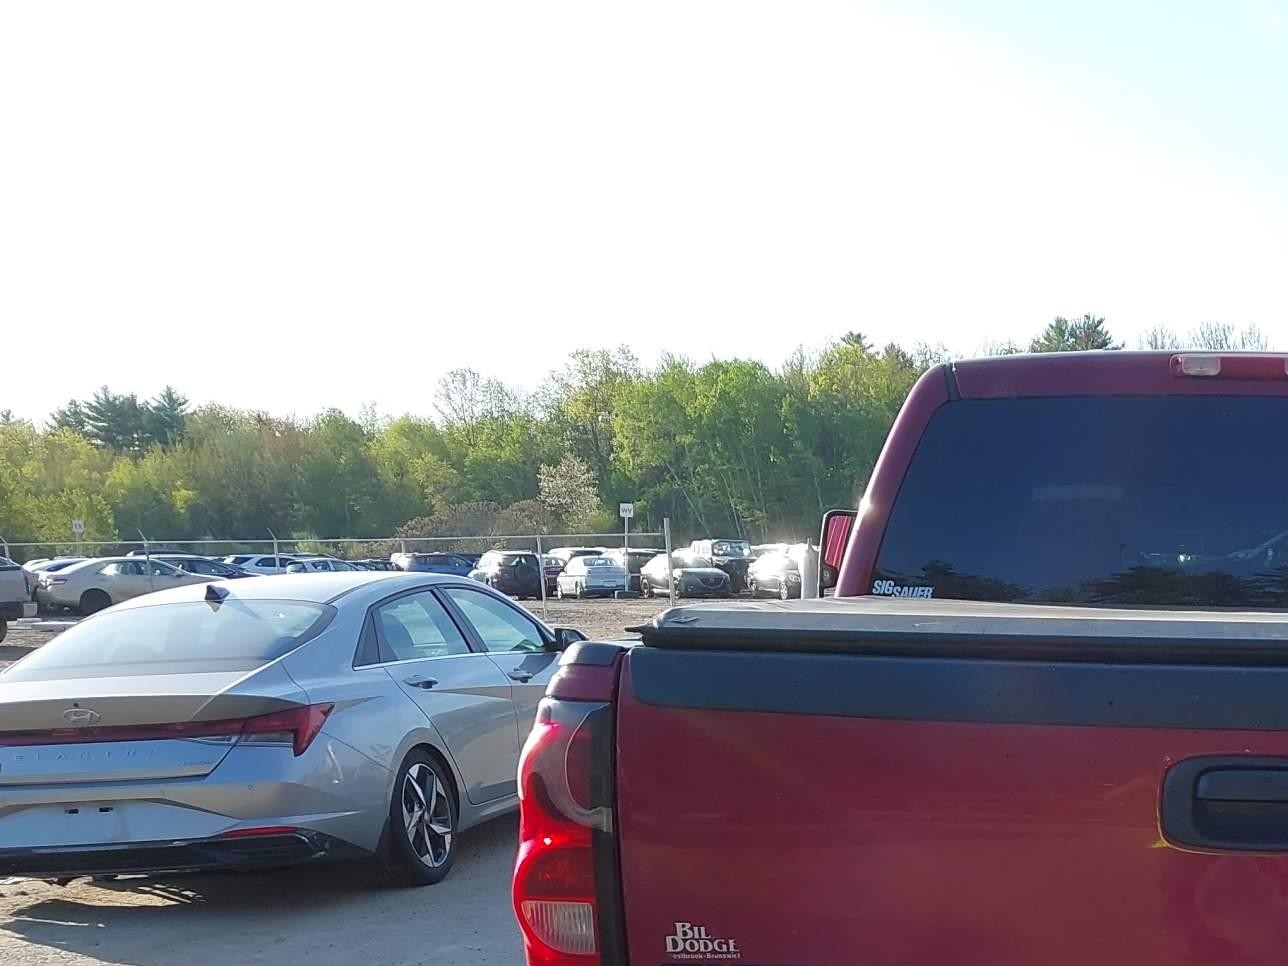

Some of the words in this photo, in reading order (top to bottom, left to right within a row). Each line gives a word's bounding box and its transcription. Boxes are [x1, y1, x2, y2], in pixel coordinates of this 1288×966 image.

[872, 580, 895, 595] SIG
[891, 586, 933, 599] SAUER
[15, 749, 159, 761] ELANTRA
